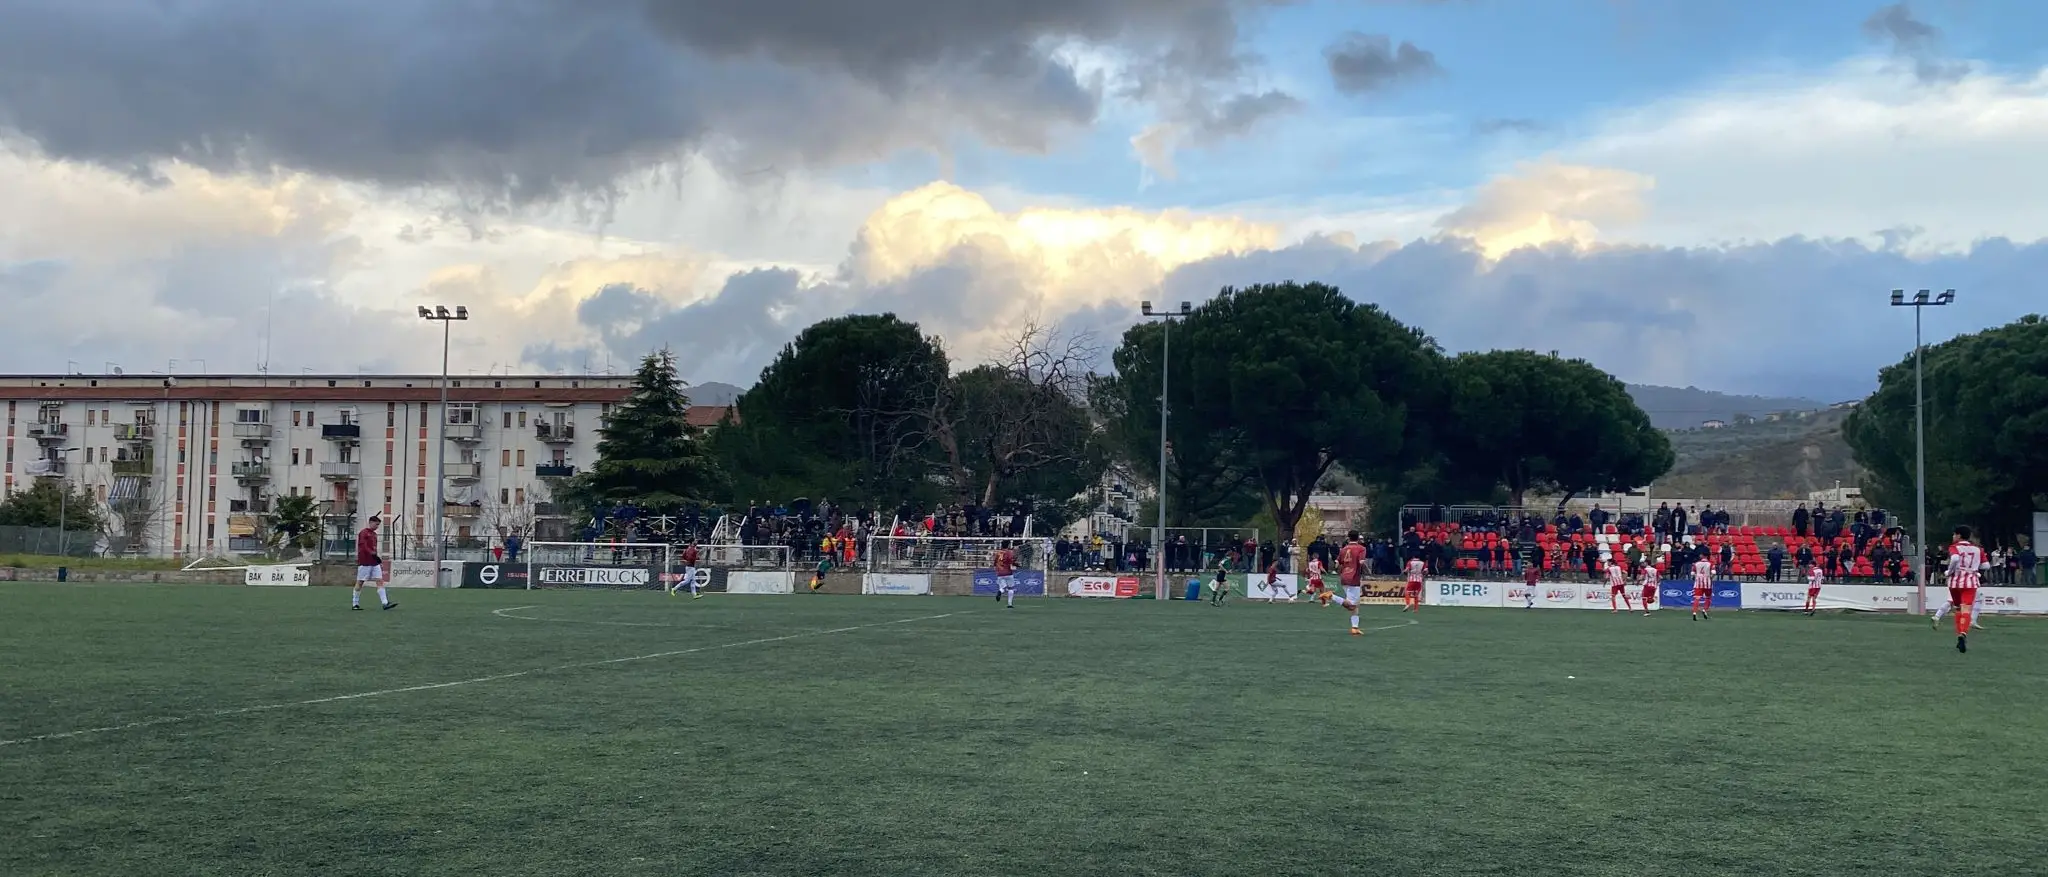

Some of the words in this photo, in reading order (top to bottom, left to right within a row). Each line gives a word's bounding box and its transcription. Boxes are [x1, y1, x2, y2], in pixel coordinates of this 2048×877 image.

[1960, 552, 1975, 568] 17
[248, 573, 262, 581] BAK
[271, 573, 285, 582] BAK
[293, 573, 307, 582] BAK
